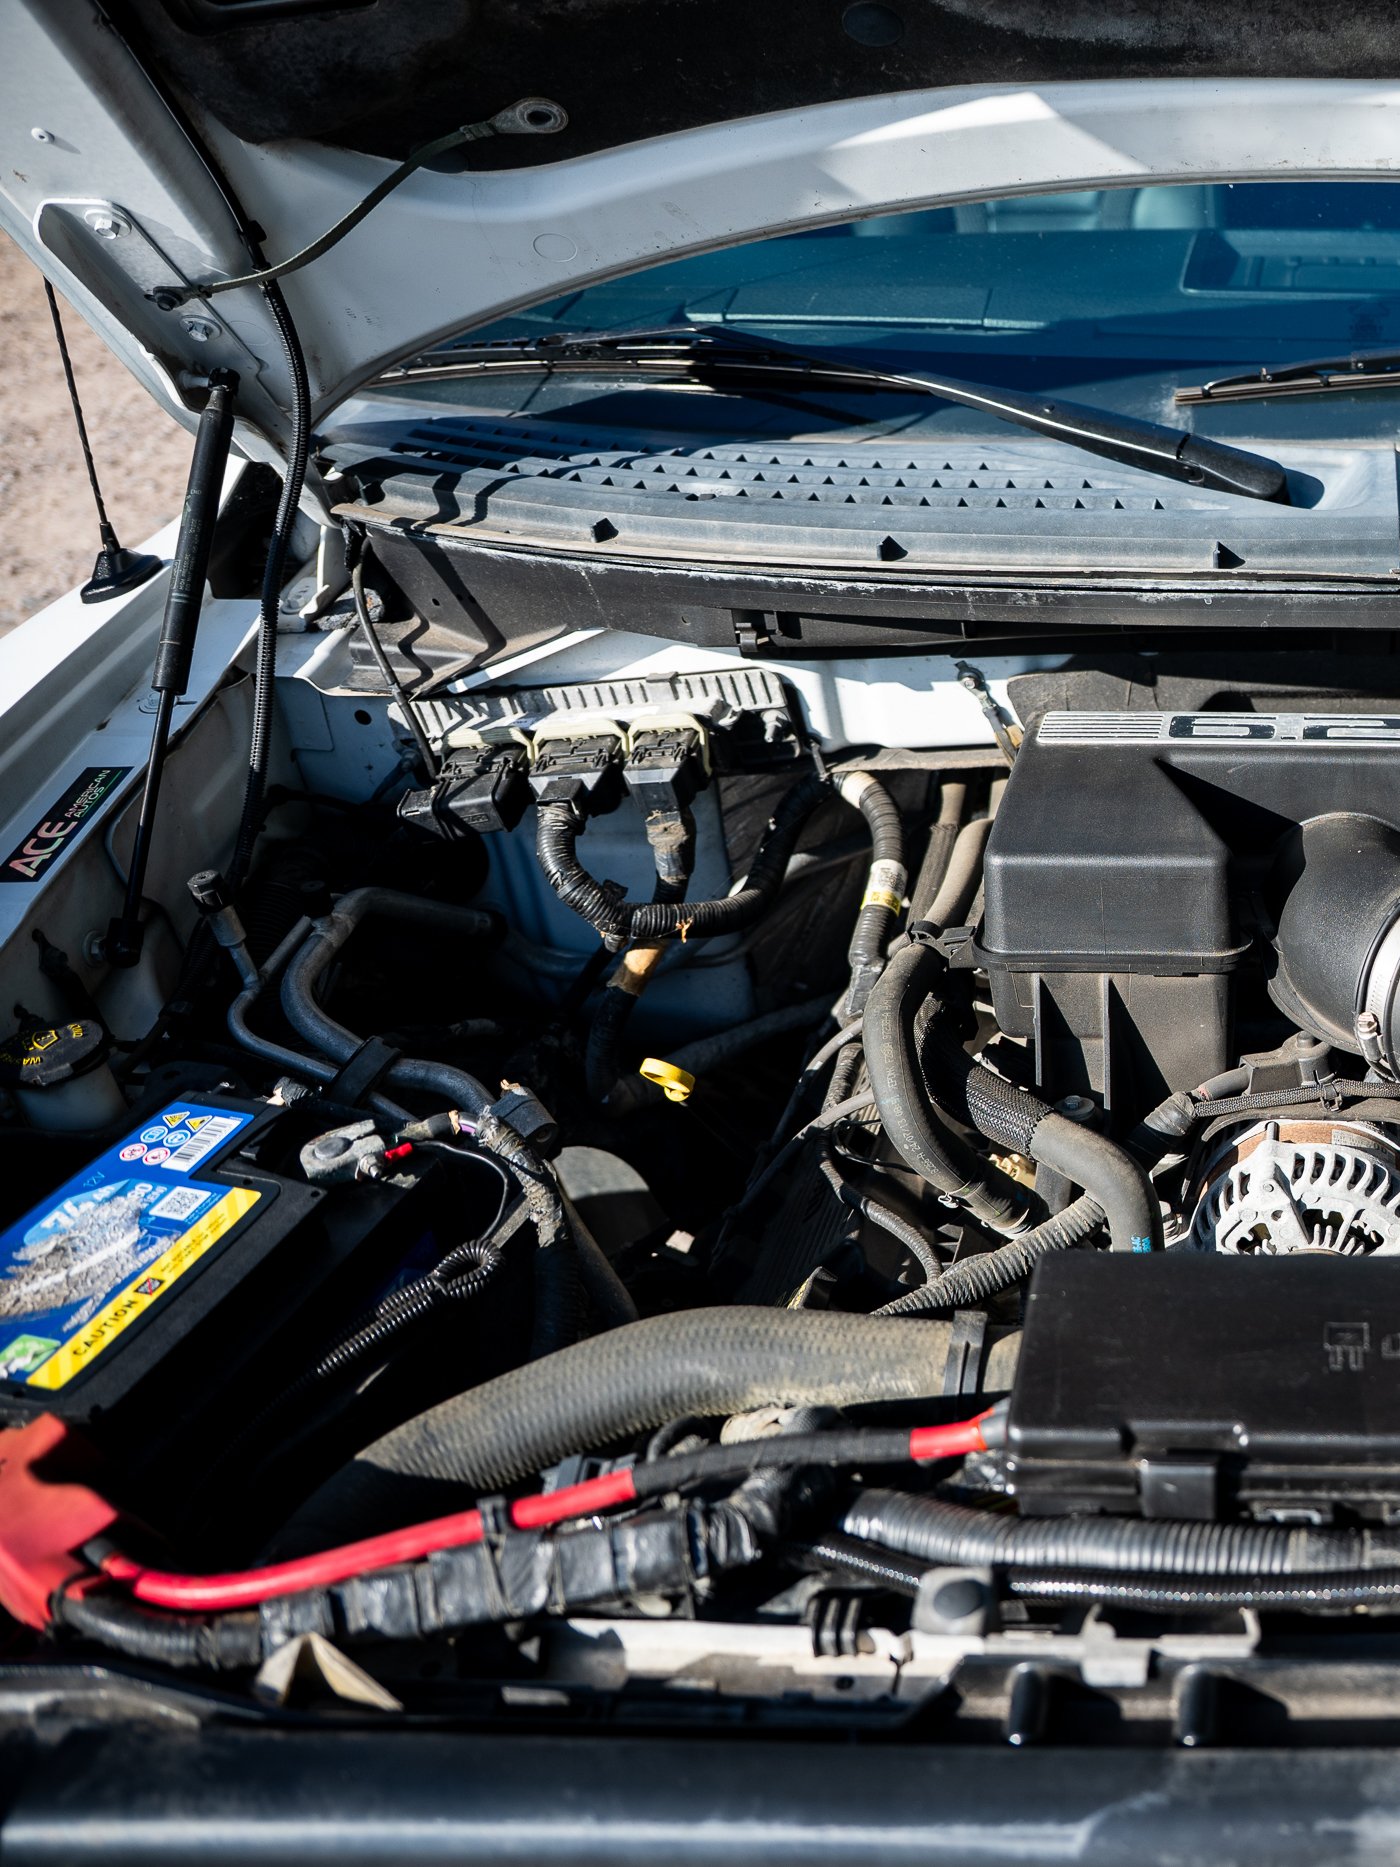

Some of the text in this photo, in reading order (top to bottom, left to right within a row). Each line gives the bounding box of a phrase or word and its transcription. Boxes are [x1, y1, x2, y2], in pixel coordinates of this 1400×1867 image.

[64, 769, 111, 818] AMERICAN
[74, 786, 105, 818] AUTOS
[9, 821, 79, 878] ACE
[73, 1299, 139, 1356] CAUTION
